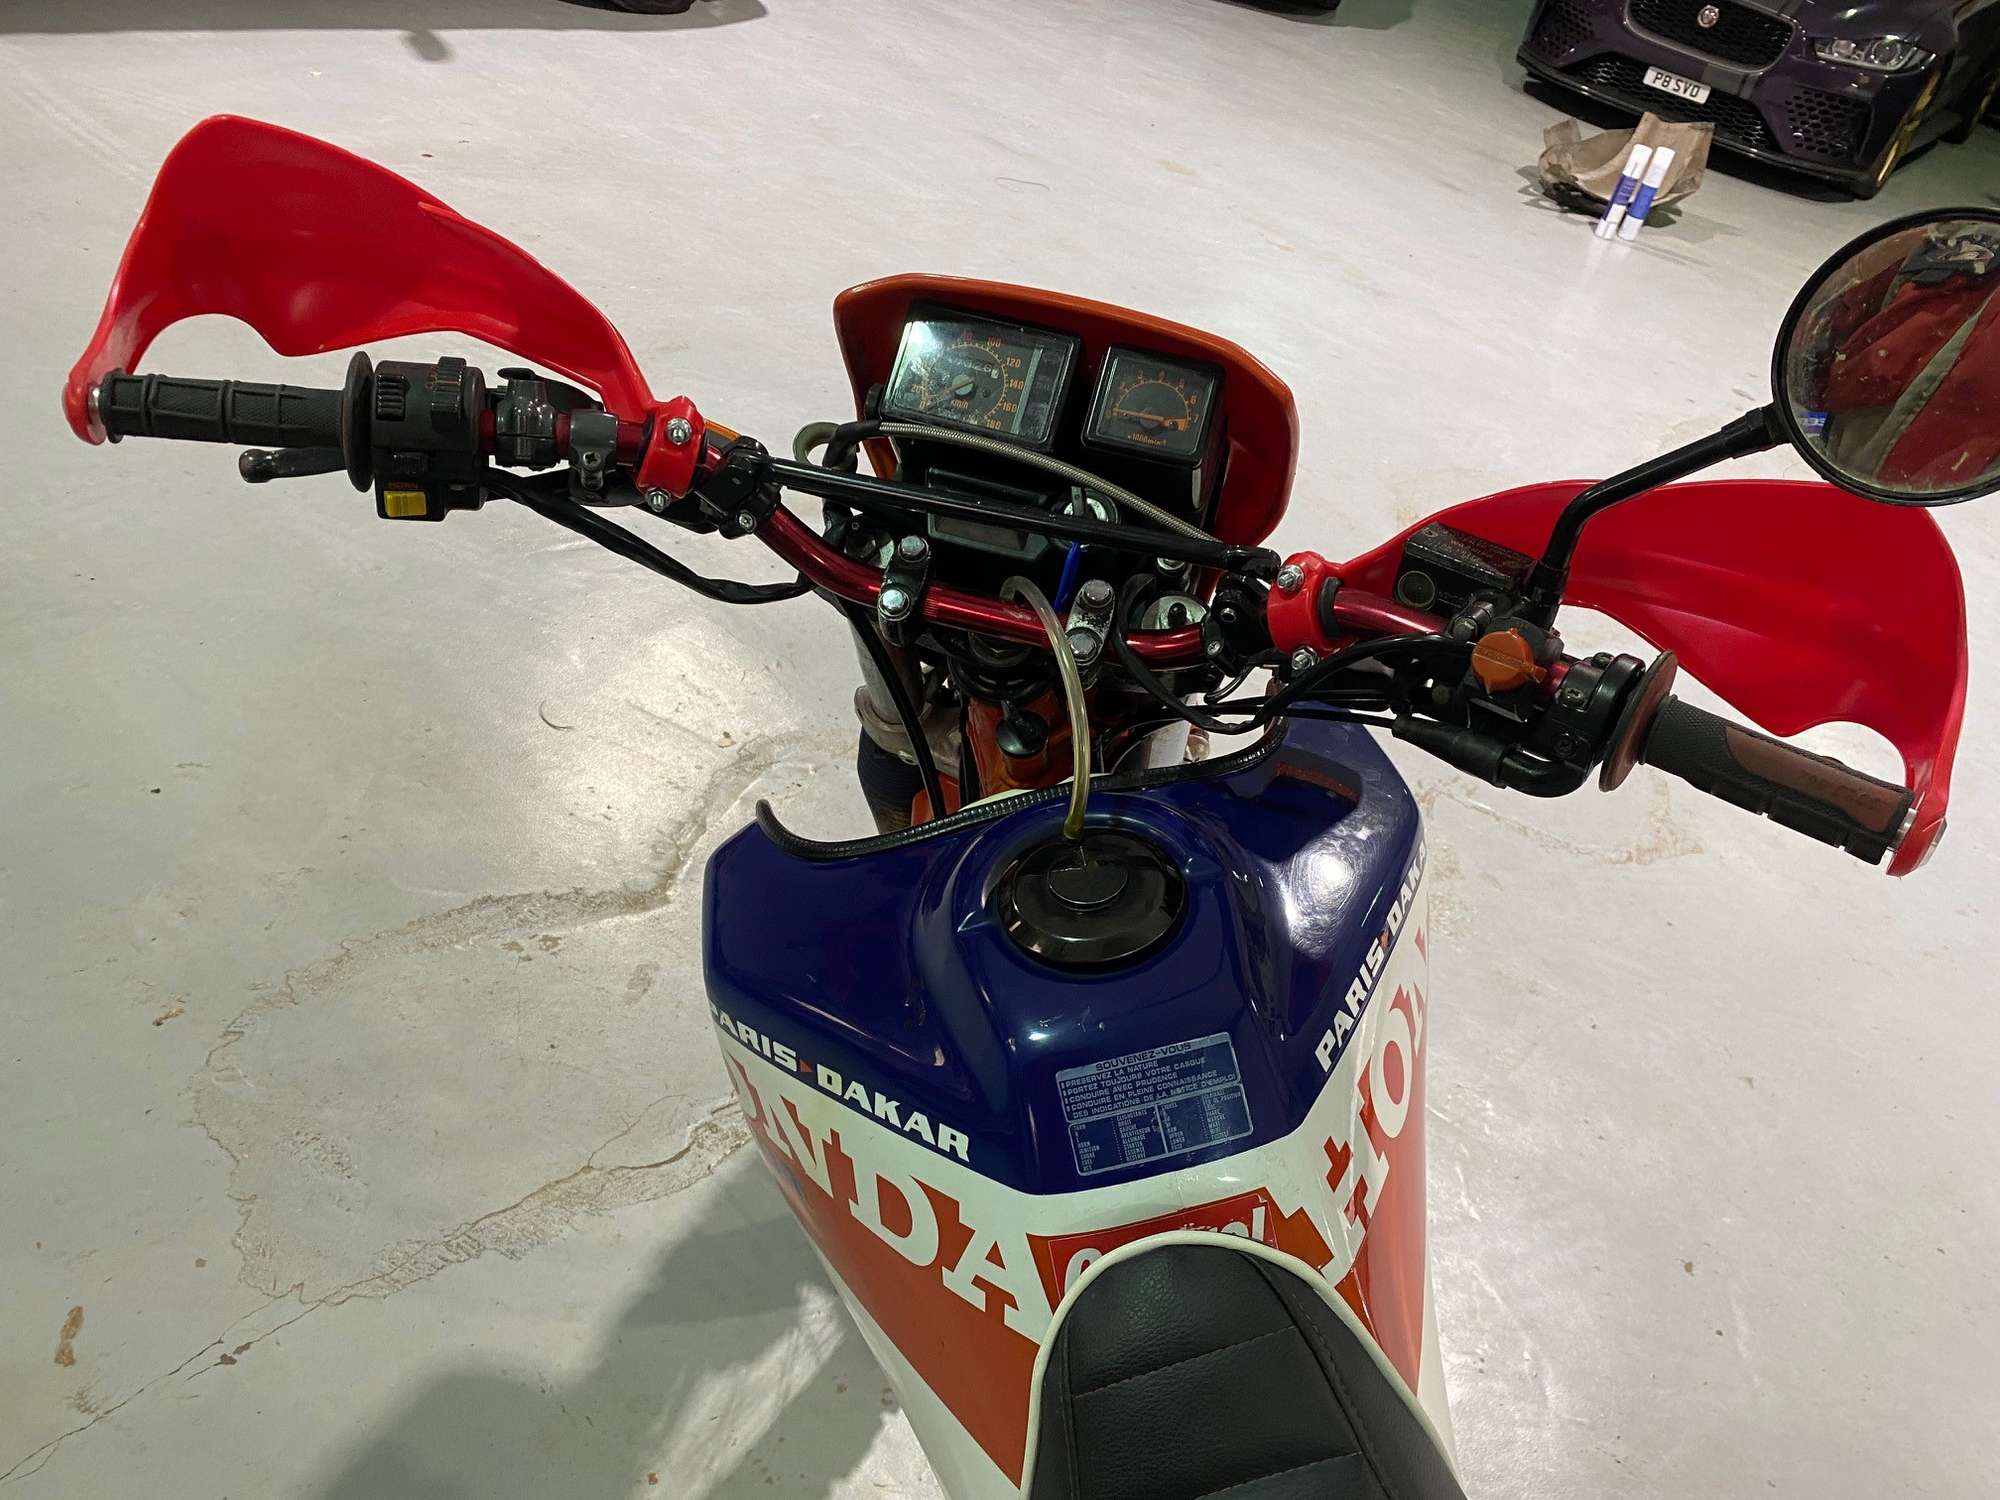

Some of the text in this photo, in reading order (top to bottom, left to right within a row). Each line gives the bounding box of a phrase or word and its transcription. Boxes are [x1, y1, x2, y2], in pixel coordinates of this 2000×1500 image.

[1006, 357, 1021, 368] 120
[1009, 380, 1024, 390] 140
[1003, 402, 1018, 412] 160
[986, 419, 1002, 430] 180
[1314, 937, 1385, 1073] PARIS
[1096, 1042, 1191, 1071] SOUVENEZ-VOUS
[1113, 1069, 1124, 1077] LA
[1127, 1060, 1159, 1073] NATURE
[1067, 1082, 1098, 1095] PORTEZ
[1101, 1072, 1142, 1087] TOUJOURS
[1145, 1065, 1171, 1077] VOTRE
[1069, 1072, 1178, 1103] CONDUIRE AVEC PRUDENCE
[1071, 1095, 1112, 1111] CONDUIRE
[1113, 1093, 1125, 1101] EN
[1128, 1085, 1154, 1098] PLEINE
[1072, 1109, 1089, 1119] DES
[1091, 1098, 1140, 1114] INDICATIONS
[1143, 1094, 1154, 1102] DE
[1157, 1091, 1168, 1100] LA
[817, 1063, 970, 1163] DAKAR
